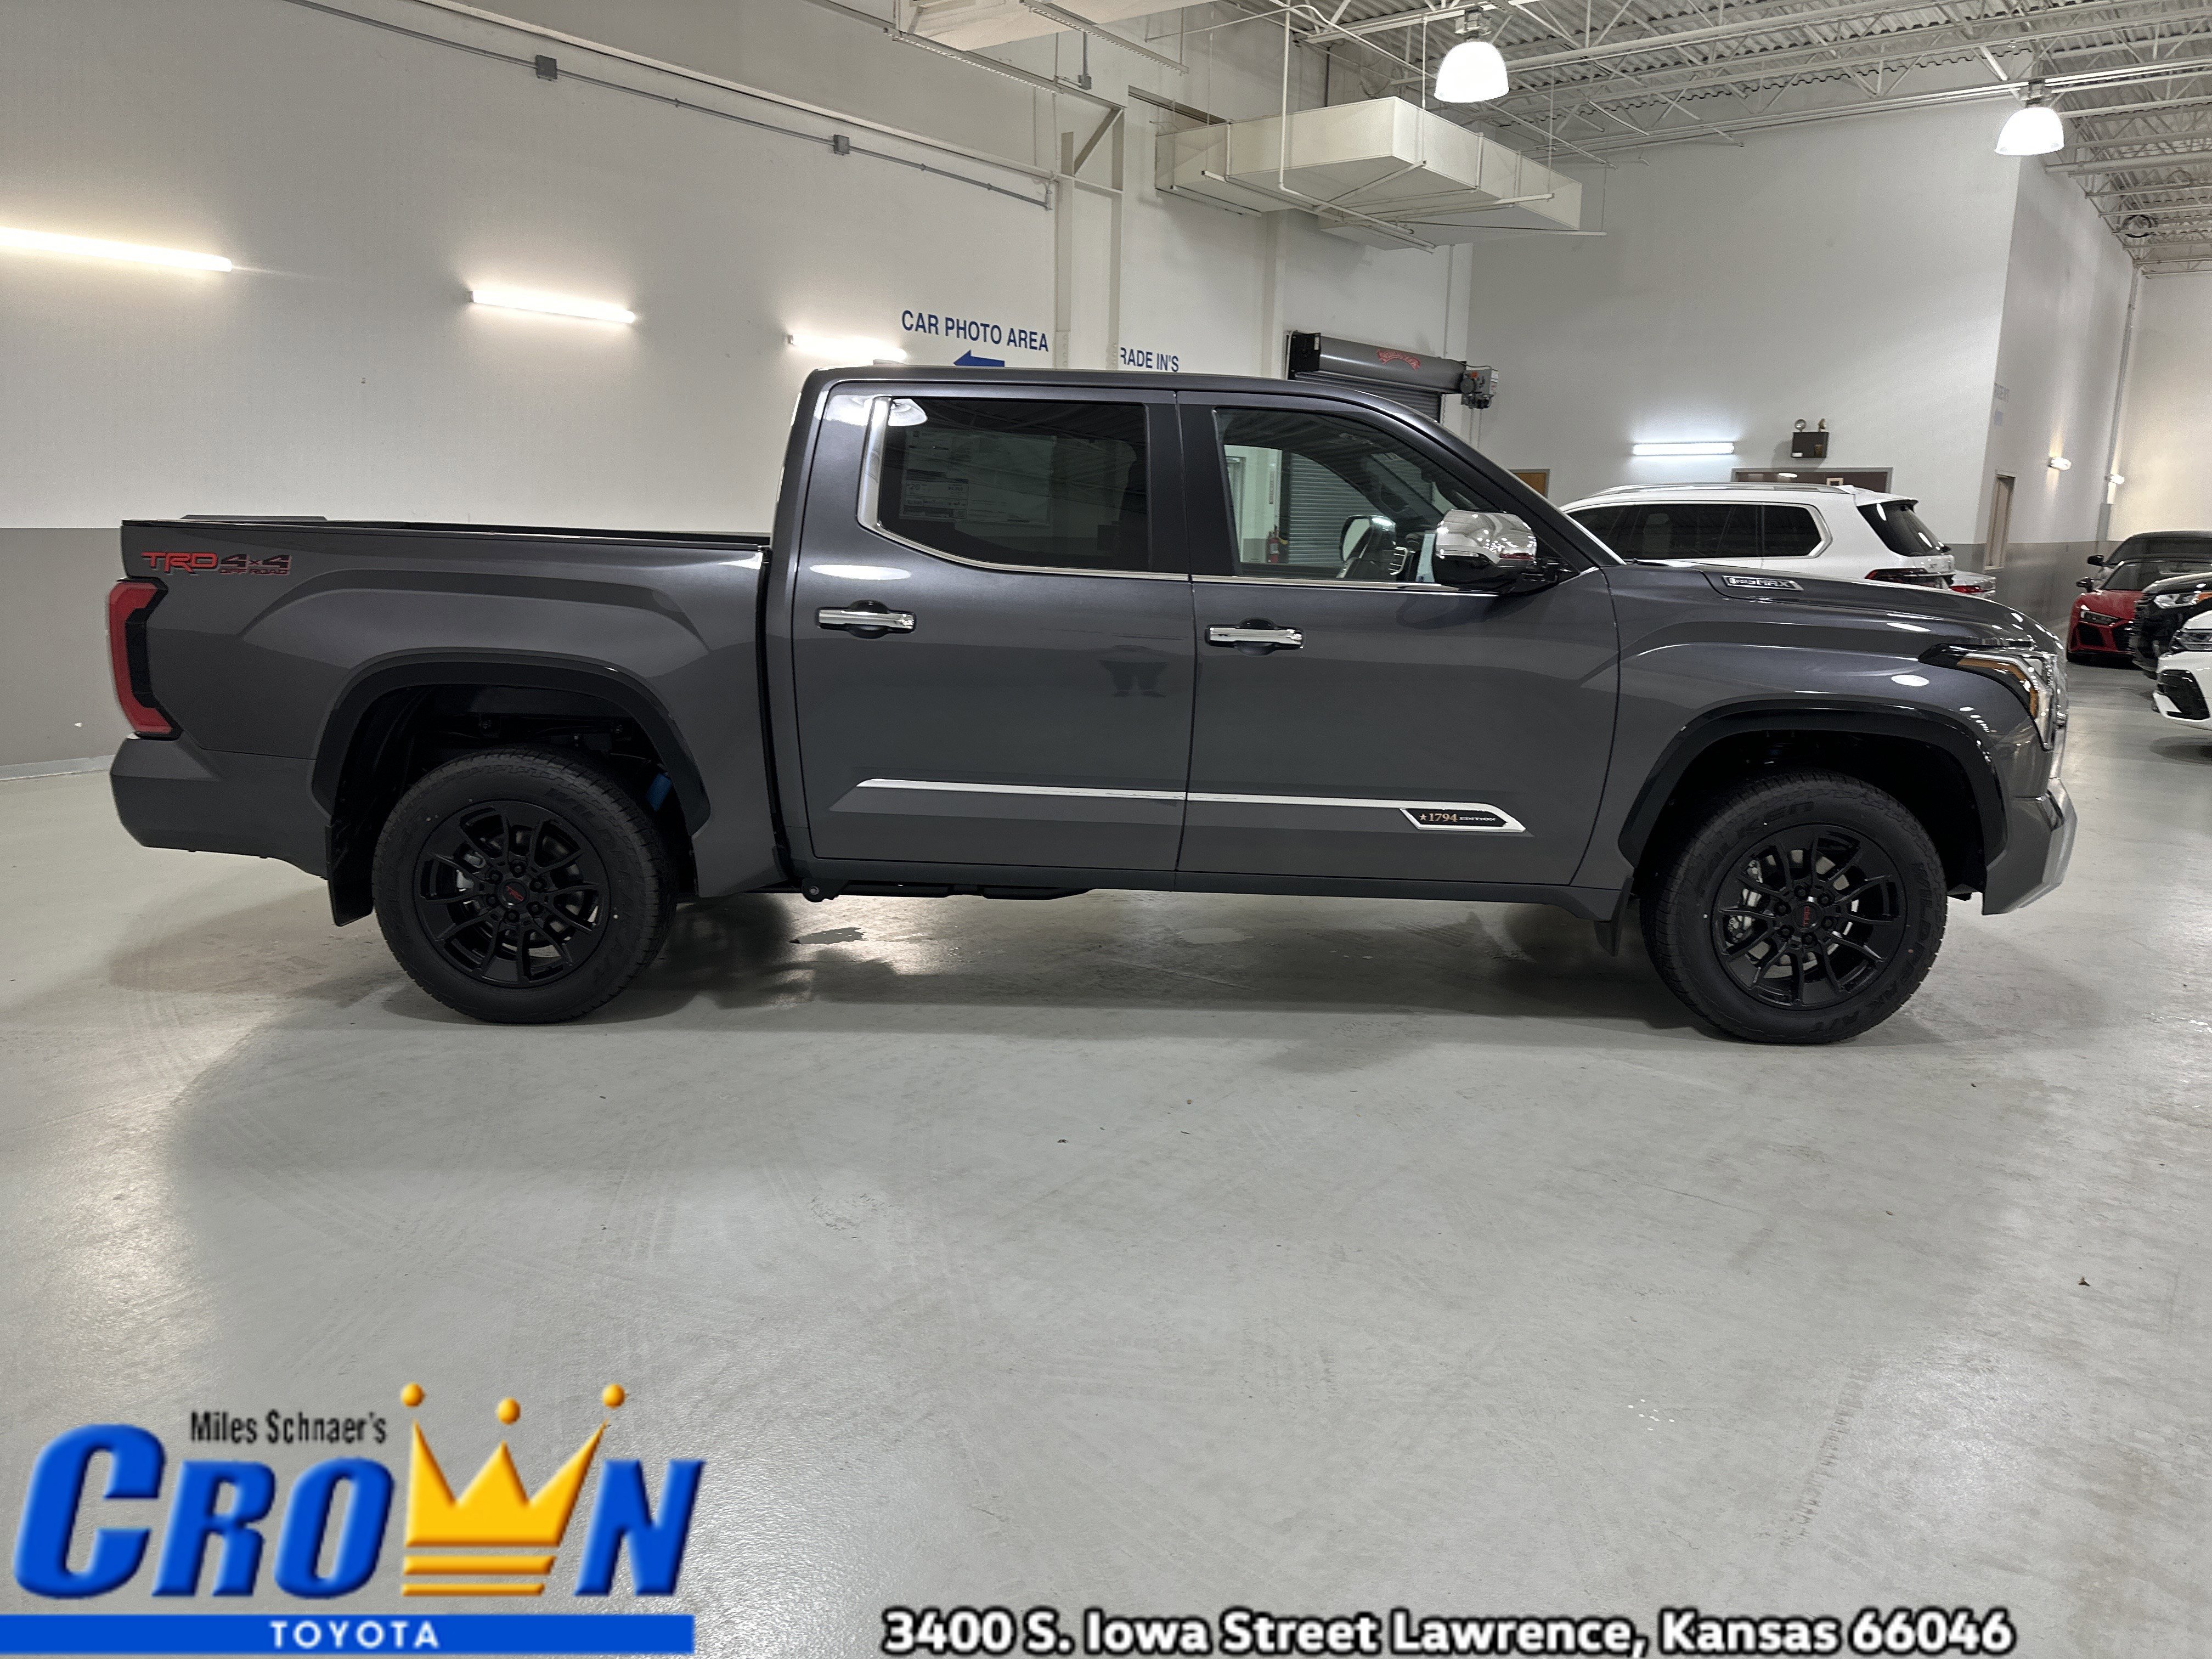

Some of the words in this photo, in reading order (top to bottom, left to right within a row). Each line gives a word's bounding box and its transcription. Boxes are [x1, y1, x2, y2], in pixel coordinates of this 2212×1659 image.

[901, 310, 939, 336] CAR
[945, 317, 1002, 345] PHOTO
[1006, 328, 1049, 352] AREA
[1120, 347, 1153, 369] RADE
[1156, 353, 1180, 373] IN'S
[141, 551, 218, 573] TRD
[1756, 579, 1791, 588] MAX
[1428, 812, 1458, 822] 1794
